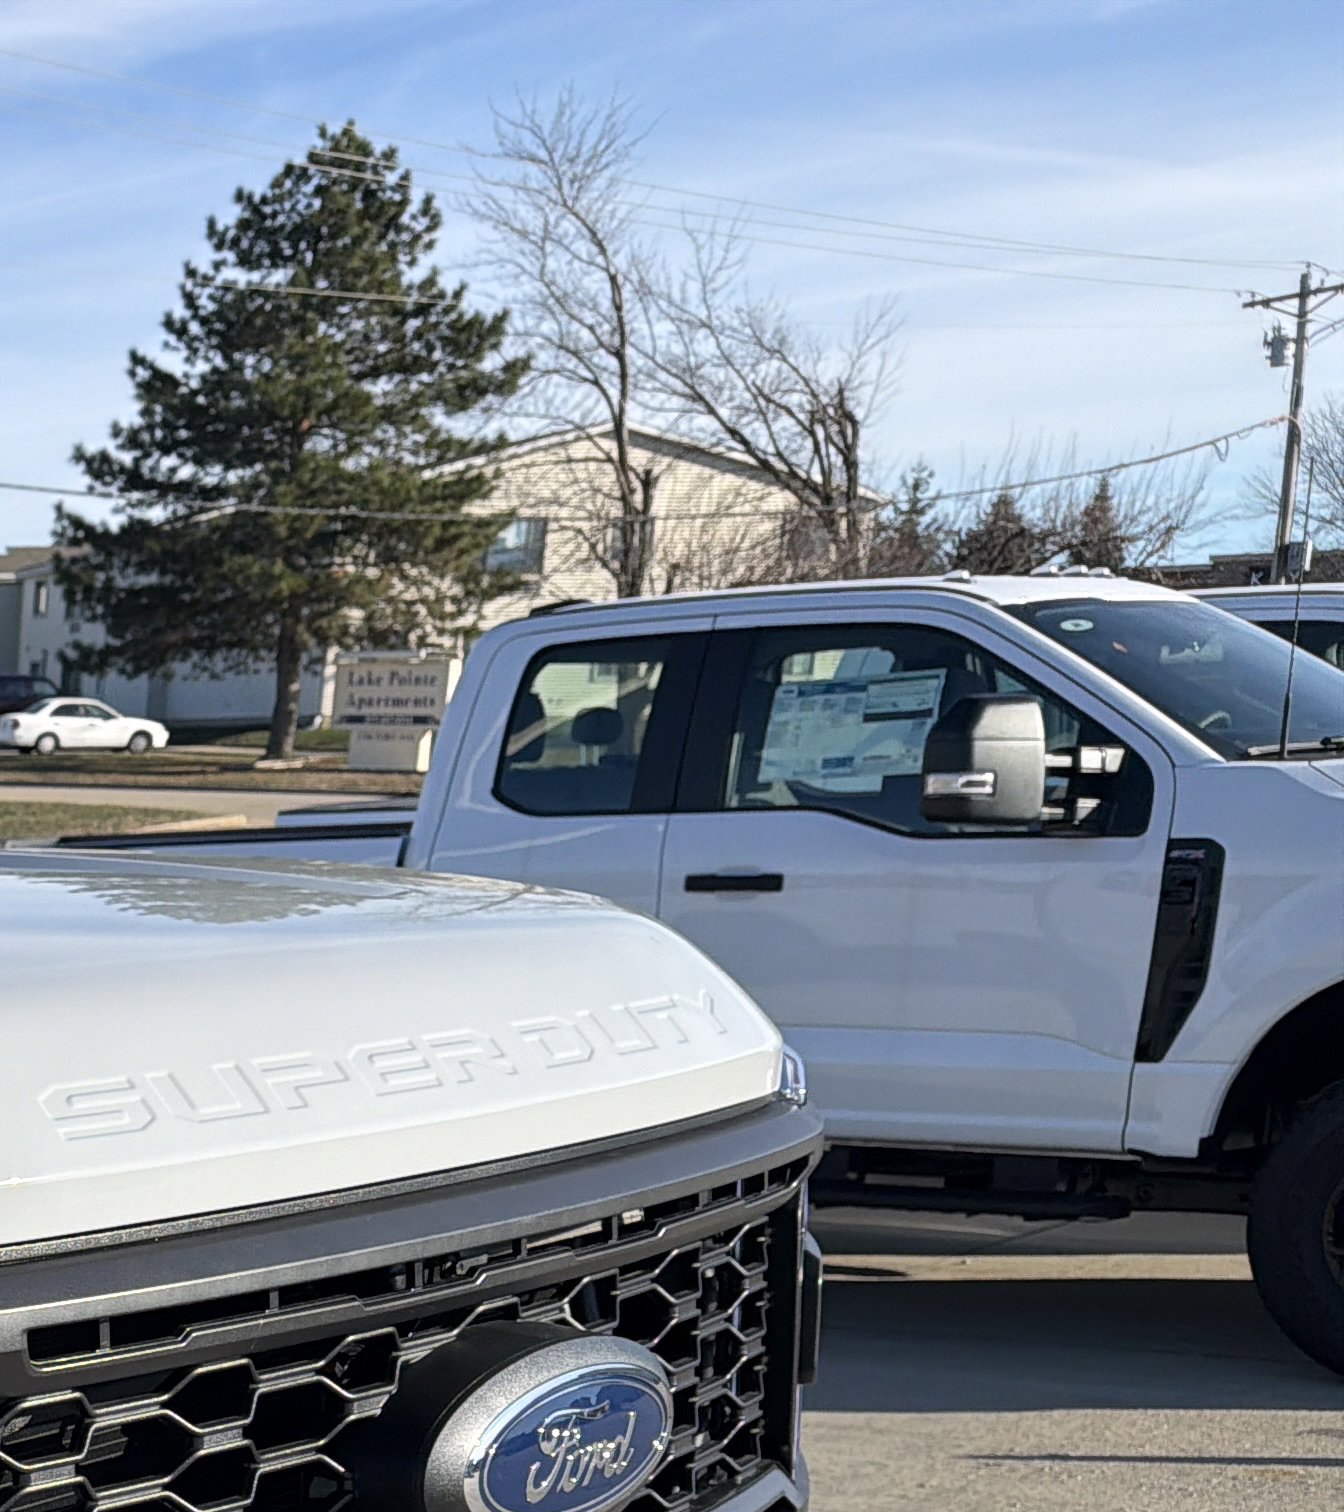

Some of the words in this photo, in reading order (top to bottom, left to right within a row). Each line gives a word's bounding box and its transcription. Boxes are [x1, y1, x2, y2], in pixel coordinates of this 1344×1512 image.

[345, 691, 437, 711] Apartments
[37, 1028, 518, 1141] SUPER
[510, 988, 727, 1069] DUTY
[526, 1400, 637, 1504] Ford
